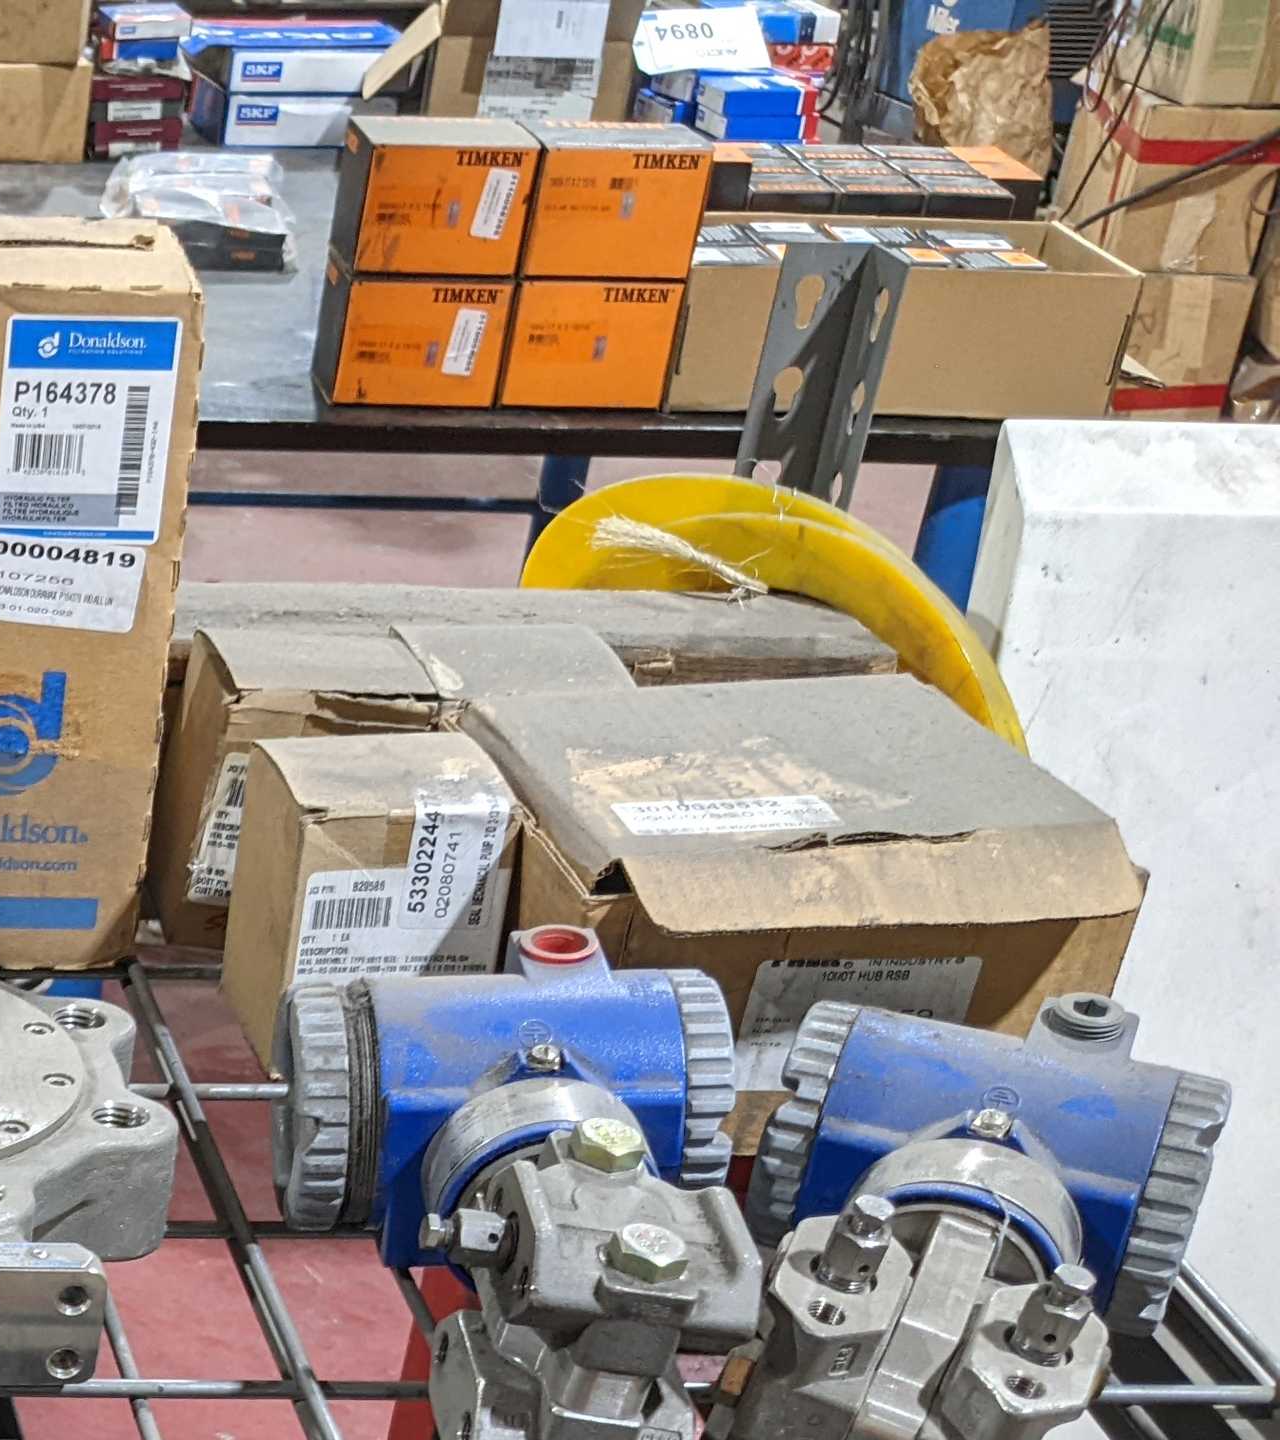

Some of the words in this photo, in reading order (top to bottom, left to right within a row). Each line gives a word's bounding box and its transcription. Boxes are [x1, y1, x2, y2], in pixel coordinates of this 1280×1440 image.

[654, 21, 714, 43] 0894
[244, 64, 280, 76] SKF
[239, 107, 276, 119] SKF
[456, 151, 523, 167] TIMKEN
[633, 154, 700, 170] TIMKEN
[433, 288, 497, 304] TIMKEN
[603, 287, 669, 303] TIMKEN
[14, 381, 116, 404] P164378
[12, 406, 38, 419] Qty.
[41, 406, 48, 417] 1
[434, 831, 462, 918] 02080741
[857, 970, 883, 981] HUB
